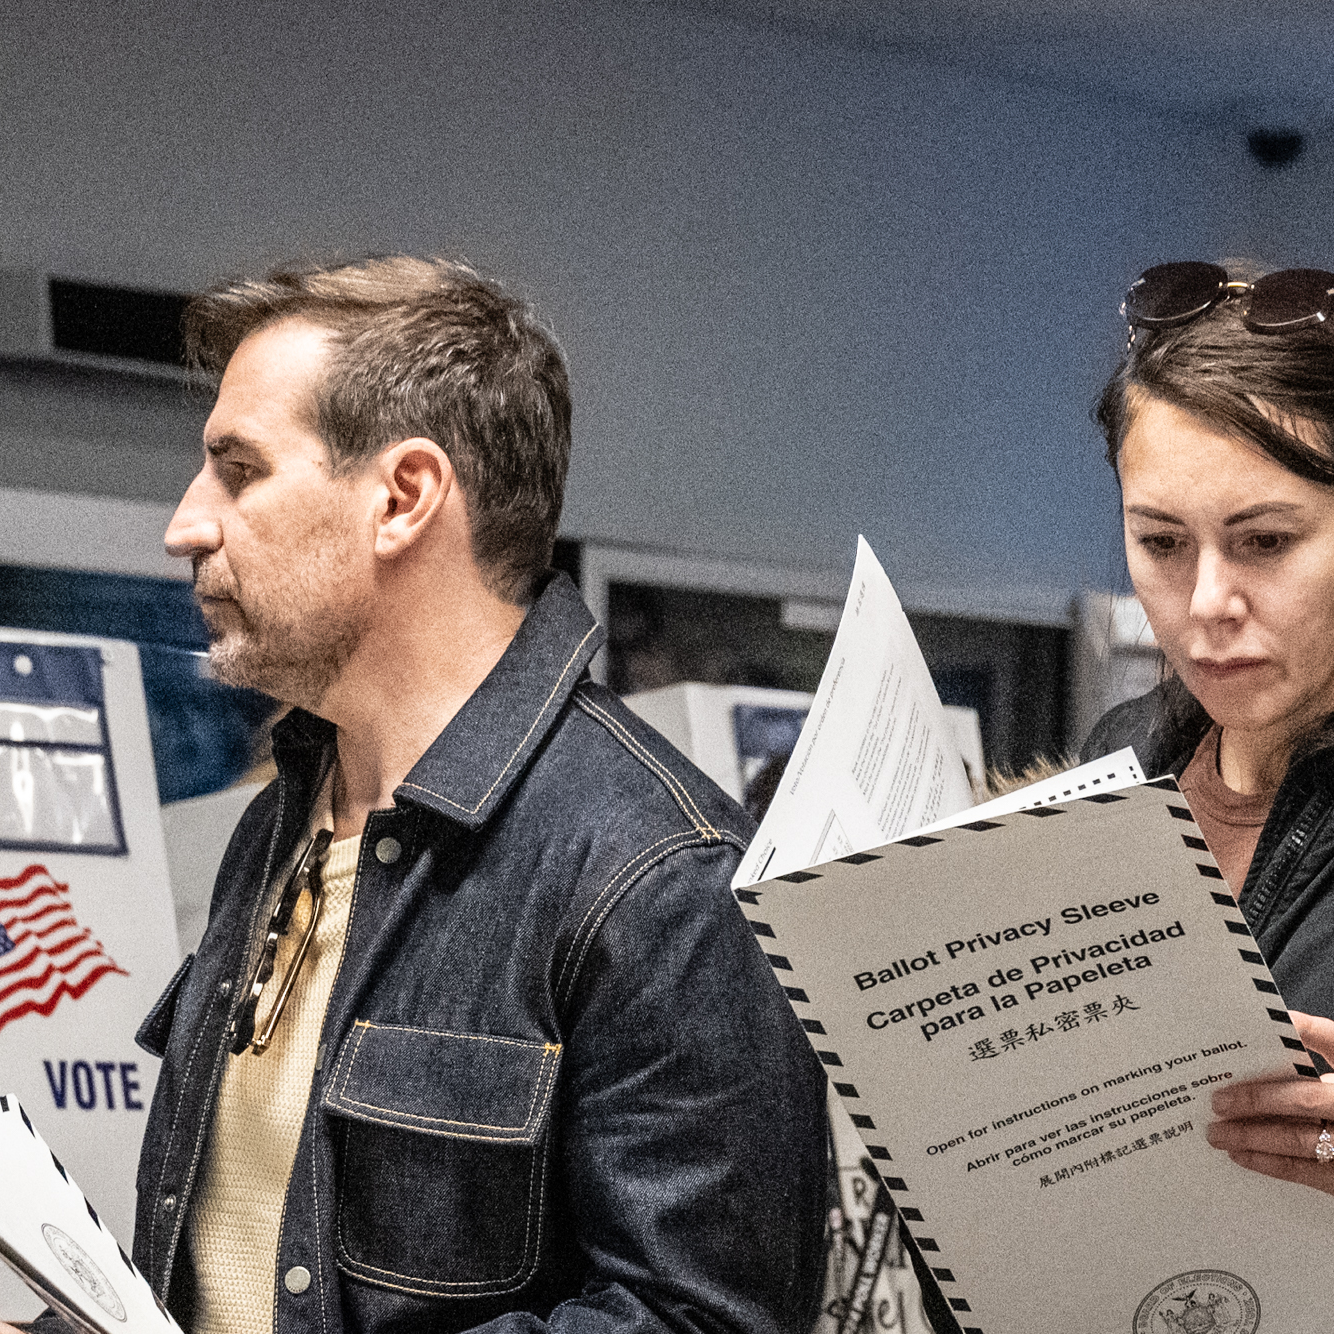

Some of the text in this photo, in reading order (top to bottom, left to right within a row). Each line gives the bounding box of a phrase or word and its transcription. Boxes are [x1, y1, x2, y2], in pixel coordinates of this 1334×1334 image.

[853, 892, 1160, 991] Ballot Privacy Sleeve
[866, 921, 1185, 1030] Carpeta de Privacidad
[920, 955, 1153, 1042] para la Papeleta
[43, 1060, 144, 1110] VOTE
[926, 1040, 1248, 1156] Open for instructions on marking your ballot.
[967, 1070, 1233, 1172] Abrir para ver las instrucciones sobre
[1012, 1094, 1196, 1167] cómo marcar su papeleta.
